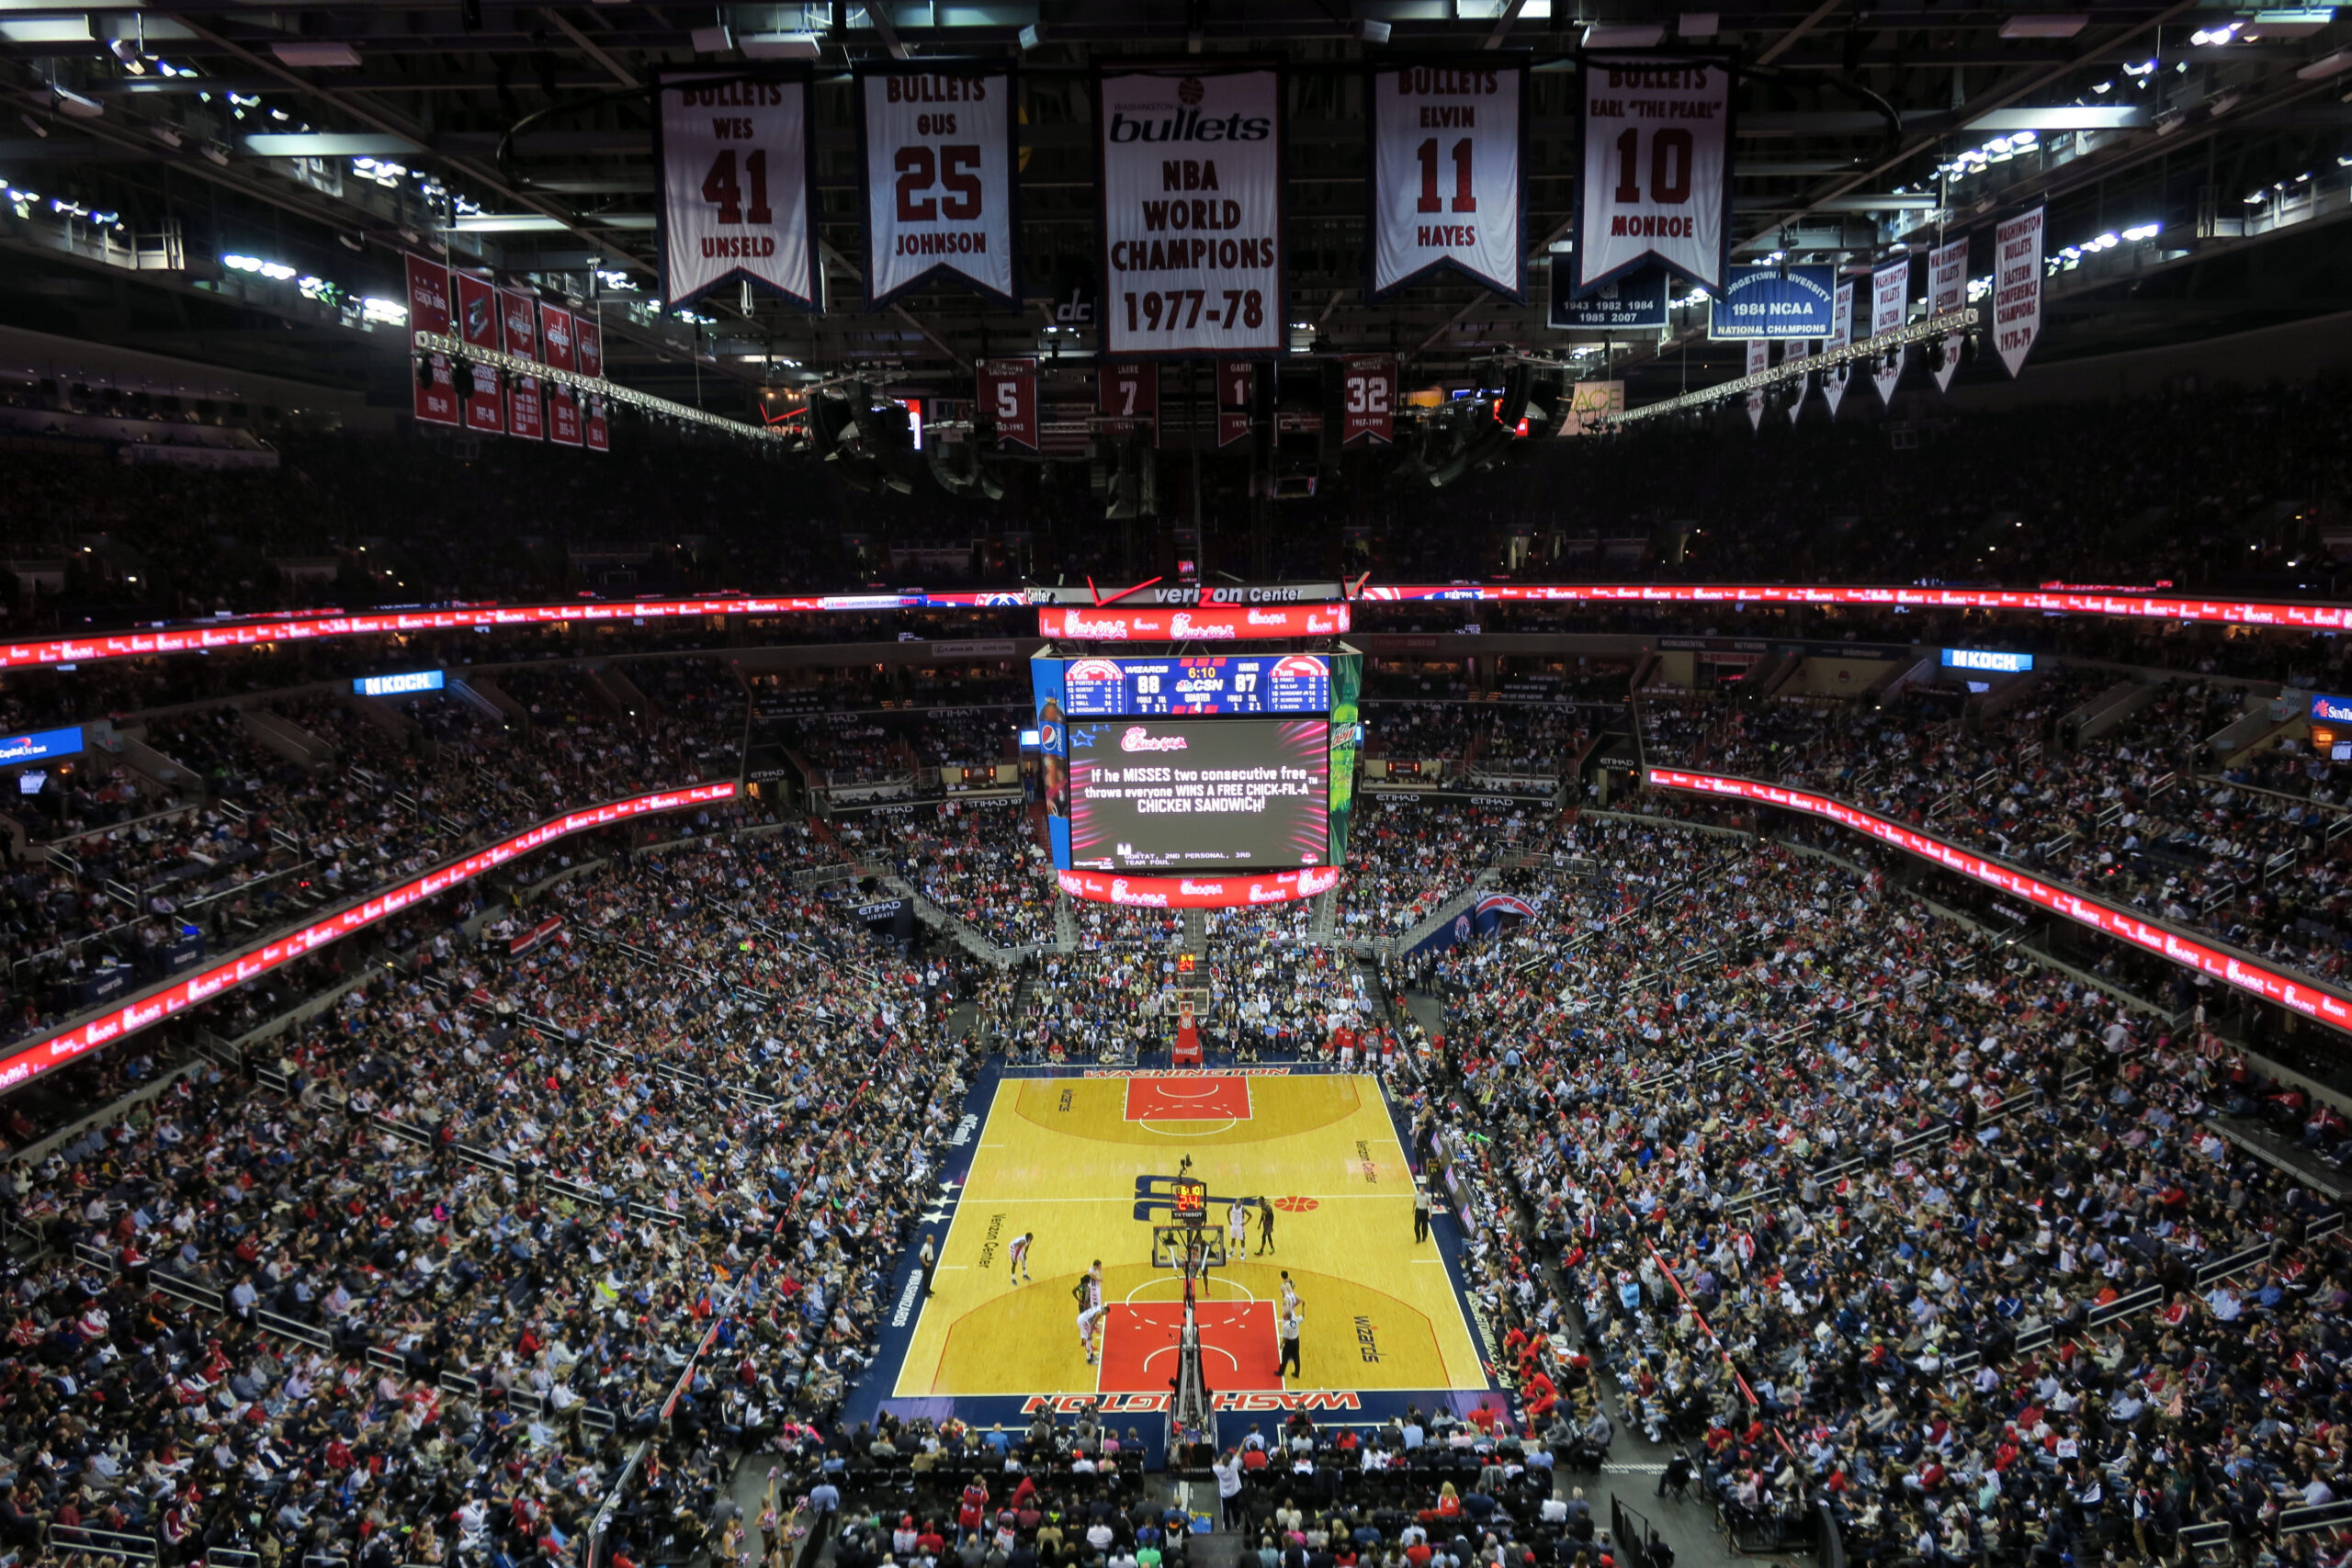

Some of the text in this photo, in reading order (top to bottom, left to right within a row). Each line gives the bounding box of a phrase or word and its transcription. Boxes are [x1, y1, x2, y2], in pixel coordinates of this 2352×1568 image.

[1398, 69, 1498, 95] BULLETS
[1609, 64, 1708, 89] BULLETS
[683, 82, 782, 107] BULLETS
[887, 75, 986, 103] BULLETS
[1420, 107, 1475, 128] ELVIN
[1590, 100, 1624, 118] EARL
[712, 118, 753, 139] WES
[917, 114, 956, 135] GUS
[1110, 106, 1271, 143] bullets
[1162, 160, 1218, 191] NBA
[1418, 138, 1476, 212] 11
[1615, 128, 1692, 204] 10
[701, 150, 772, 224] 41
[895, 145, 981, 221] 25
[1143, 200, 1241, 231] WORLD
[1418, 226, 1475, 246] HAYES
[1611, 215, 1692, 237] MONROE
[1997, 213, 2041, 244] WASHINGTON
[702, 237, 775, 257] UNSELD
[896, 232, 986, 255] JOHNSON
[2005, 237, 2031, 260] BULLETS
[1112, 238, 1274, 271] CHAMPIONS
[1930, 244, 1968, 267] WASHINGTON
[1874, 266, 1906, 289] WASHINGTON
[1937, 265, 1960, 285] BULLETS
[2004, 264, 2030, 286] EASTERN
[1880, 286, 1900, 304] BULLETS
[1996, 280, 2037, 306] CONFERENCE
[1057, 288, 1092, 321] dc
[1125, 289, 1263, 332] 1977-78
[1564, 300, 1654, 310] 1943 1982 1984
[1732, 301, 1814, 316] 1984 NCAA
[1997, 299, 2035, 324] CHAMPIONS
[1579, 312, 1637, 322] 1985 2007
[1879, 309, 1899, 325] EASTERN
[1717, 323, 1826, 335] NATIONAL CHAMPIONS
[2000, 327, 2031, 351] 1978-79
[997, 382, 1018, 418] 5
[1120, 381, 1137, 416] 7
[1347, 377, 1388, 412] 32
[1154, 583, 1304, 608] verizon Center
[1661, 639, 1706, 649] MONUMENTAL
[1125, 665, 1169, 673] WIZARDS
[1188, 667, 1216, 679] 6:10
[1238, 662, 1260, 671] HAWKS
[1137, 675, 1159, 694] 88
[1193, 679, 1224, 691] CSN
[1235, 673, 1257, 693] 87
[1136, 695, 1152, 704] FOULS
[1184, 693, 1211, 703] QUARTER
[1194, 701, 1202, 713] 4
[1227, 694, 1242, 703] FOULS
[1600, 758, 1634, 766] ETIHAD
[751, 769, 785, 779] ETIHAD
[1091, 765, 1306, 783] If he MISSES two consecutive free
[1084, 786, 1122, 798] throws
[1125, 787, 1173, 799] everyone
[1175, 784, 1204, 796] WINS
[1207, 784, 1216, 796] A
[1217, 784, 1244, 796] FREE
[1246, 783, 1309, 796] CHICK-FIL-A
[1376, 794, 1420, 803] ETIHAD
[872, 806, 914, 816] ETIHAD
[1137, 795, 1266, 813] CHICKEN SANDWICH!
[1471, 796, 1514, 807] ETIHAD
[1184, 852, 1229, 860] PERSONAL,
[858, 900, 901, 916] ETIHAD
[867, 911, 894, 921] AIRWAYS
[1178, 960, 1194, 972] 24
[1083, 1067, 1291, 1078] WASHINGTON
[1356, 1140, 1377, 1184] Verizon Center
[1181, 1186, 1201, 1195] 6:10
[1177, 1195, 1199, 1211] 24
[978, 1213, 1007, 1269] Verizon Center
[1354, 1315, 1385, 1364] wizards
